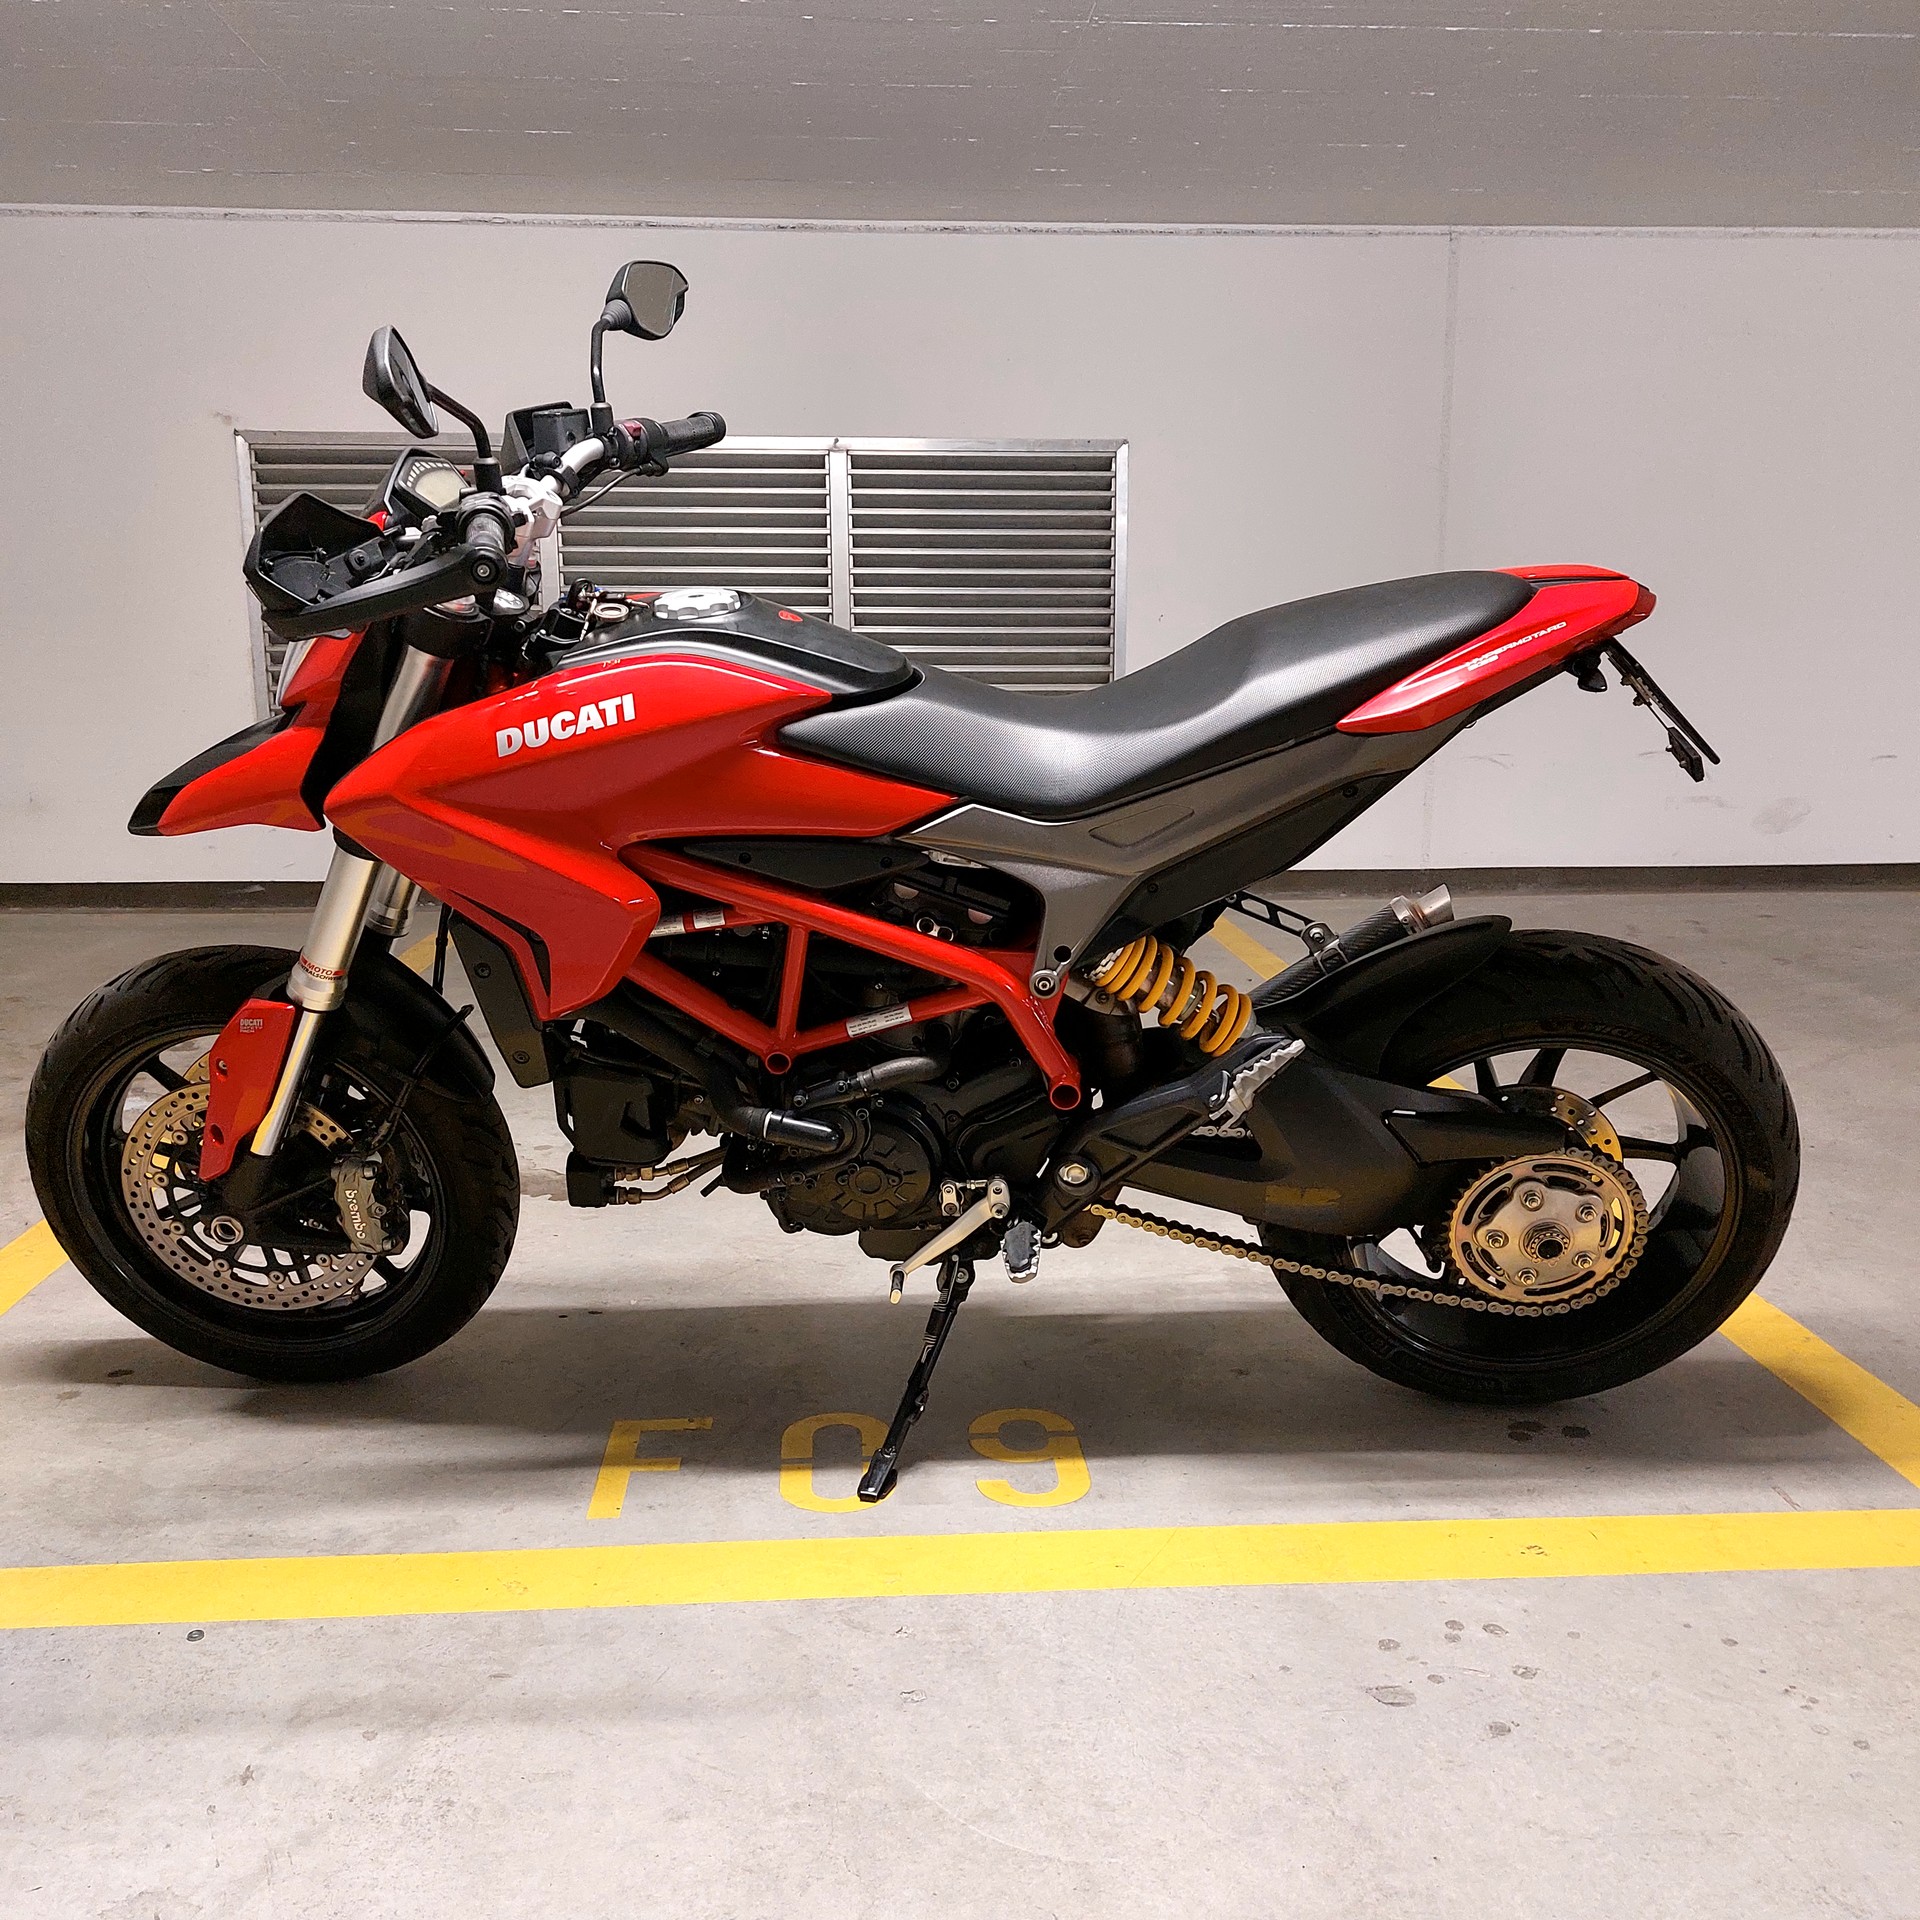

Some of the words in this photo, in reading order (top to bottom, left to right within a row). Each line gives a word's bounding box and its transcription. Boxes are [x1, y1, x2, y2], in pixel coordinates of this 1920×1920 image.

[496, 693, 636, 757] DUCATI
[306, 962, 333, 976] MOTO
[240, 1018, 263, 1027] DUCATI
[344, 1189, 367, 1239] brembo
